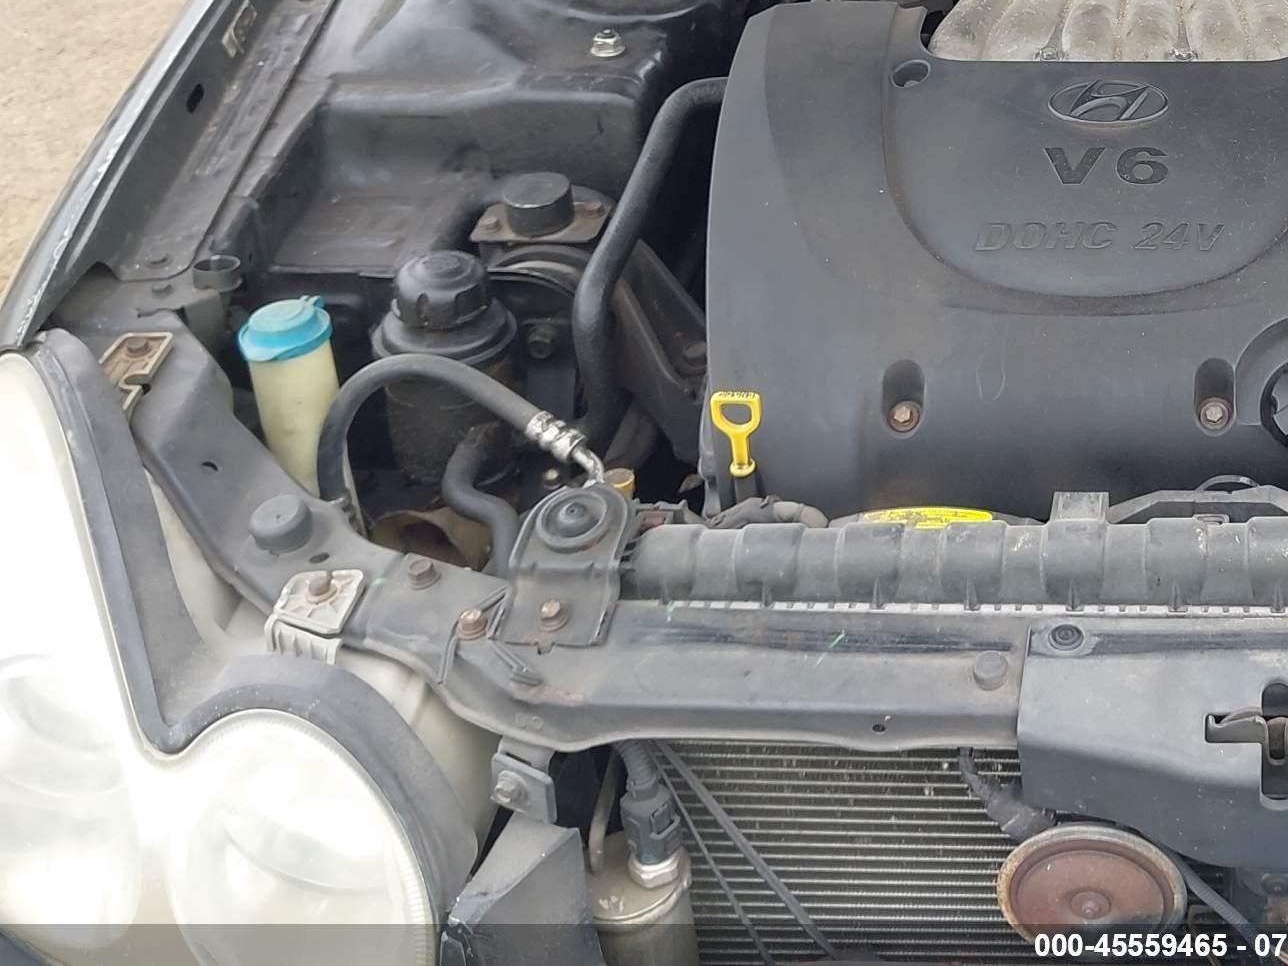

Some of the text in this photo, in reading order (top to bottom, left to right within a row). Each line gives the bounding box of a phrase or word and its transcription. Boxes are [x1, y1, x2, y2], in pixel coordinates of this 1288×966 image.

[1043, 146, 1169, 185] V6
[974, 221, 1225, 252] DOHC 24V
